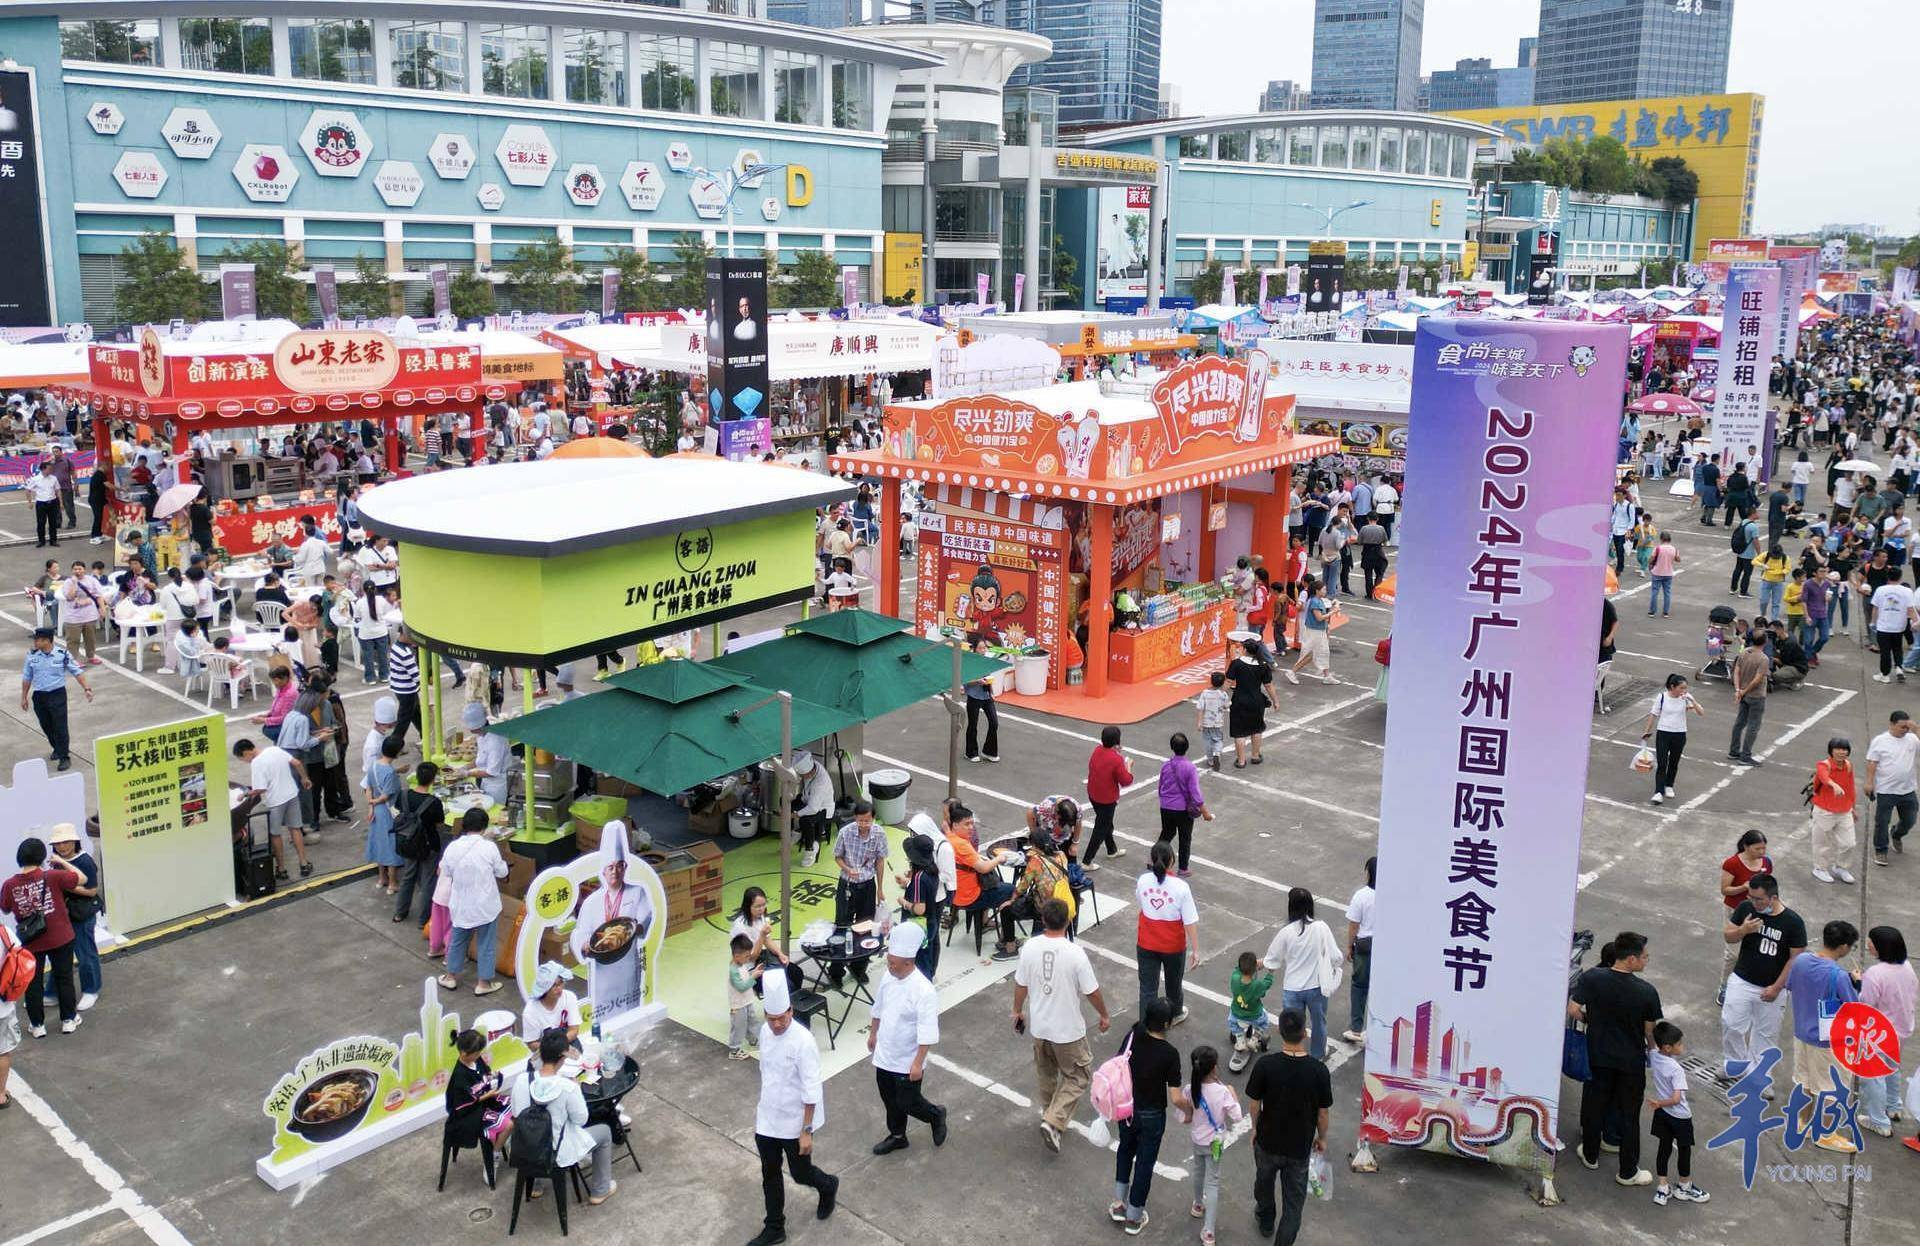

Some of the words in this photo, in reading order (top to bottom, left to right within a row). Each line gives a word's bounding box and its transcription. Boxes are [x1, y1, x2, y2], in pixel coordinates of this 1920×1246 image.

[508, 152, 548, 165] 七彩人生
[786, 164, 813, 207] D
[830, 335, 879, 356] 廣順興
[1733, 291, 1763, 386] 旺铺招租
[291, 339, 385, 366] 山東老家
[1438, 342, 1526, 365] 食尚羊城
[187, 361, 269, 383] 创新演绎
[1300, 361, 1392, 374] 庄臣美食坊
[1491, 363, 1564, 378] 味荟天下
[1172, 369, 1245, 414] 尽兴劲爽
[953, 408, 1035, 433] 尽兴劲爽
[973, 436, 1018, 446] 中国健力宝
[944, 535, 992, 552] 吃货新装备
[954, 520, 1001, 538] 民族品牌
[1004, 527, 1053, 545] 中国味道
[943, 548, 987, 563] 美食配健力宝
[625, 585, 648, 606] IN
[653, 571, 711, 600] GUANG
[715, 560, 756, 583] ZHOU
[653, 584, 732, 620] 广州美食地标
[1042, 569, 1056, 645] 中国健力宝
[1442, 408, 1535, 993] 2024年广州国际美食节
[116, 738, 208, 772] 5大核心要素
[1759, 924, 1782, 941] LAND
